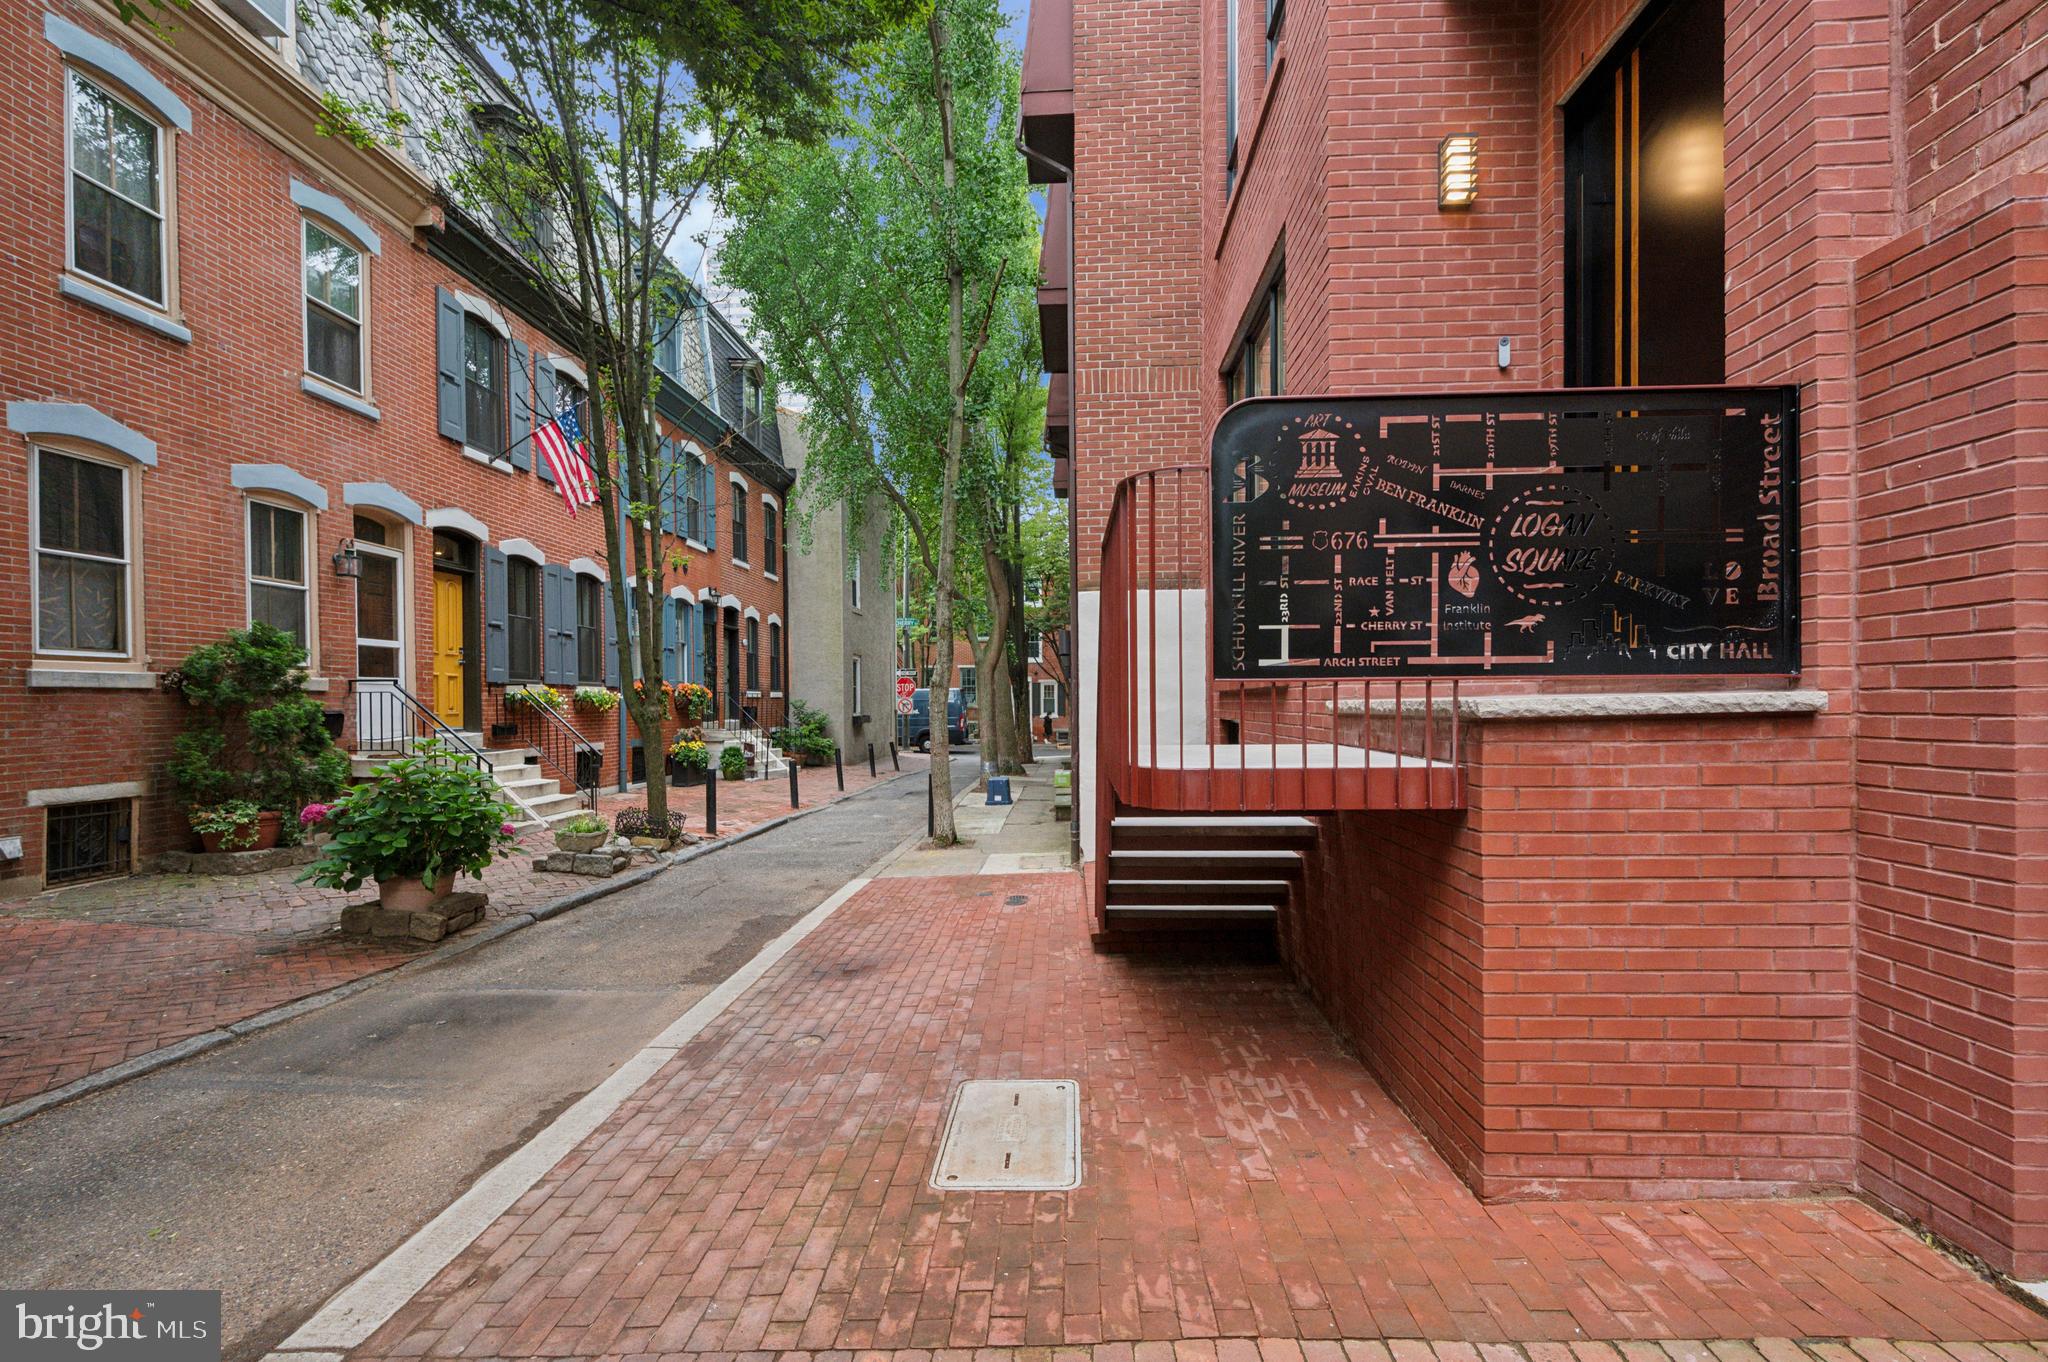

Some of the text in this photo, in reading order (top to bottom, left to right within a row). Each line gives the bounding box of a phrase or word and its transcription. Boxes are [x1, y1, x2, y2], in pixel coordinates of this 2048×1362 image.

[1304, 413, 1333, 428] ART
[1548, 411, 1558, 425] ST
[1431, 414, 1441, 456] 21ST ST
[1486, 412, 1496, 459] 20TH ST
[1349, 456, 1370, 498] EAKINS
[1363, 465, 1379, 496] OVAL
[1288, 481, 1348, 497] MUSEUM
[1449, 480, 1486, 500] BARNES
[1375, 478, 1486, 530] BEN FRANKLIN
[1757, 413, 1782, 601] Broad Street
[1510, 512, 1595, 538] LOGAN
[1232, 513, 1246, 567] RIVER
[1331, 531, 1368, 550] 676
[1501, 546, 1604, 576] SQUARE
[1349, 575, 1424, 586] RACE ST
[1385, 557, 1395, 616] VAN PELT
[1279, 575, 1290, 622] 23RD ST
[1333, 578, 1343, 625] 22ND ST
[1444, 603, 1491, 614] Franklin
[1360, 620, 1424, 631] CHERRY ST
[1443, 620, 1492, 631] Institute
[1323, 656, 1401, 667] ARCH STREET
[1666, 641, 1774, 660] CITY HALL
[897, 683, 915, 692] STOP
